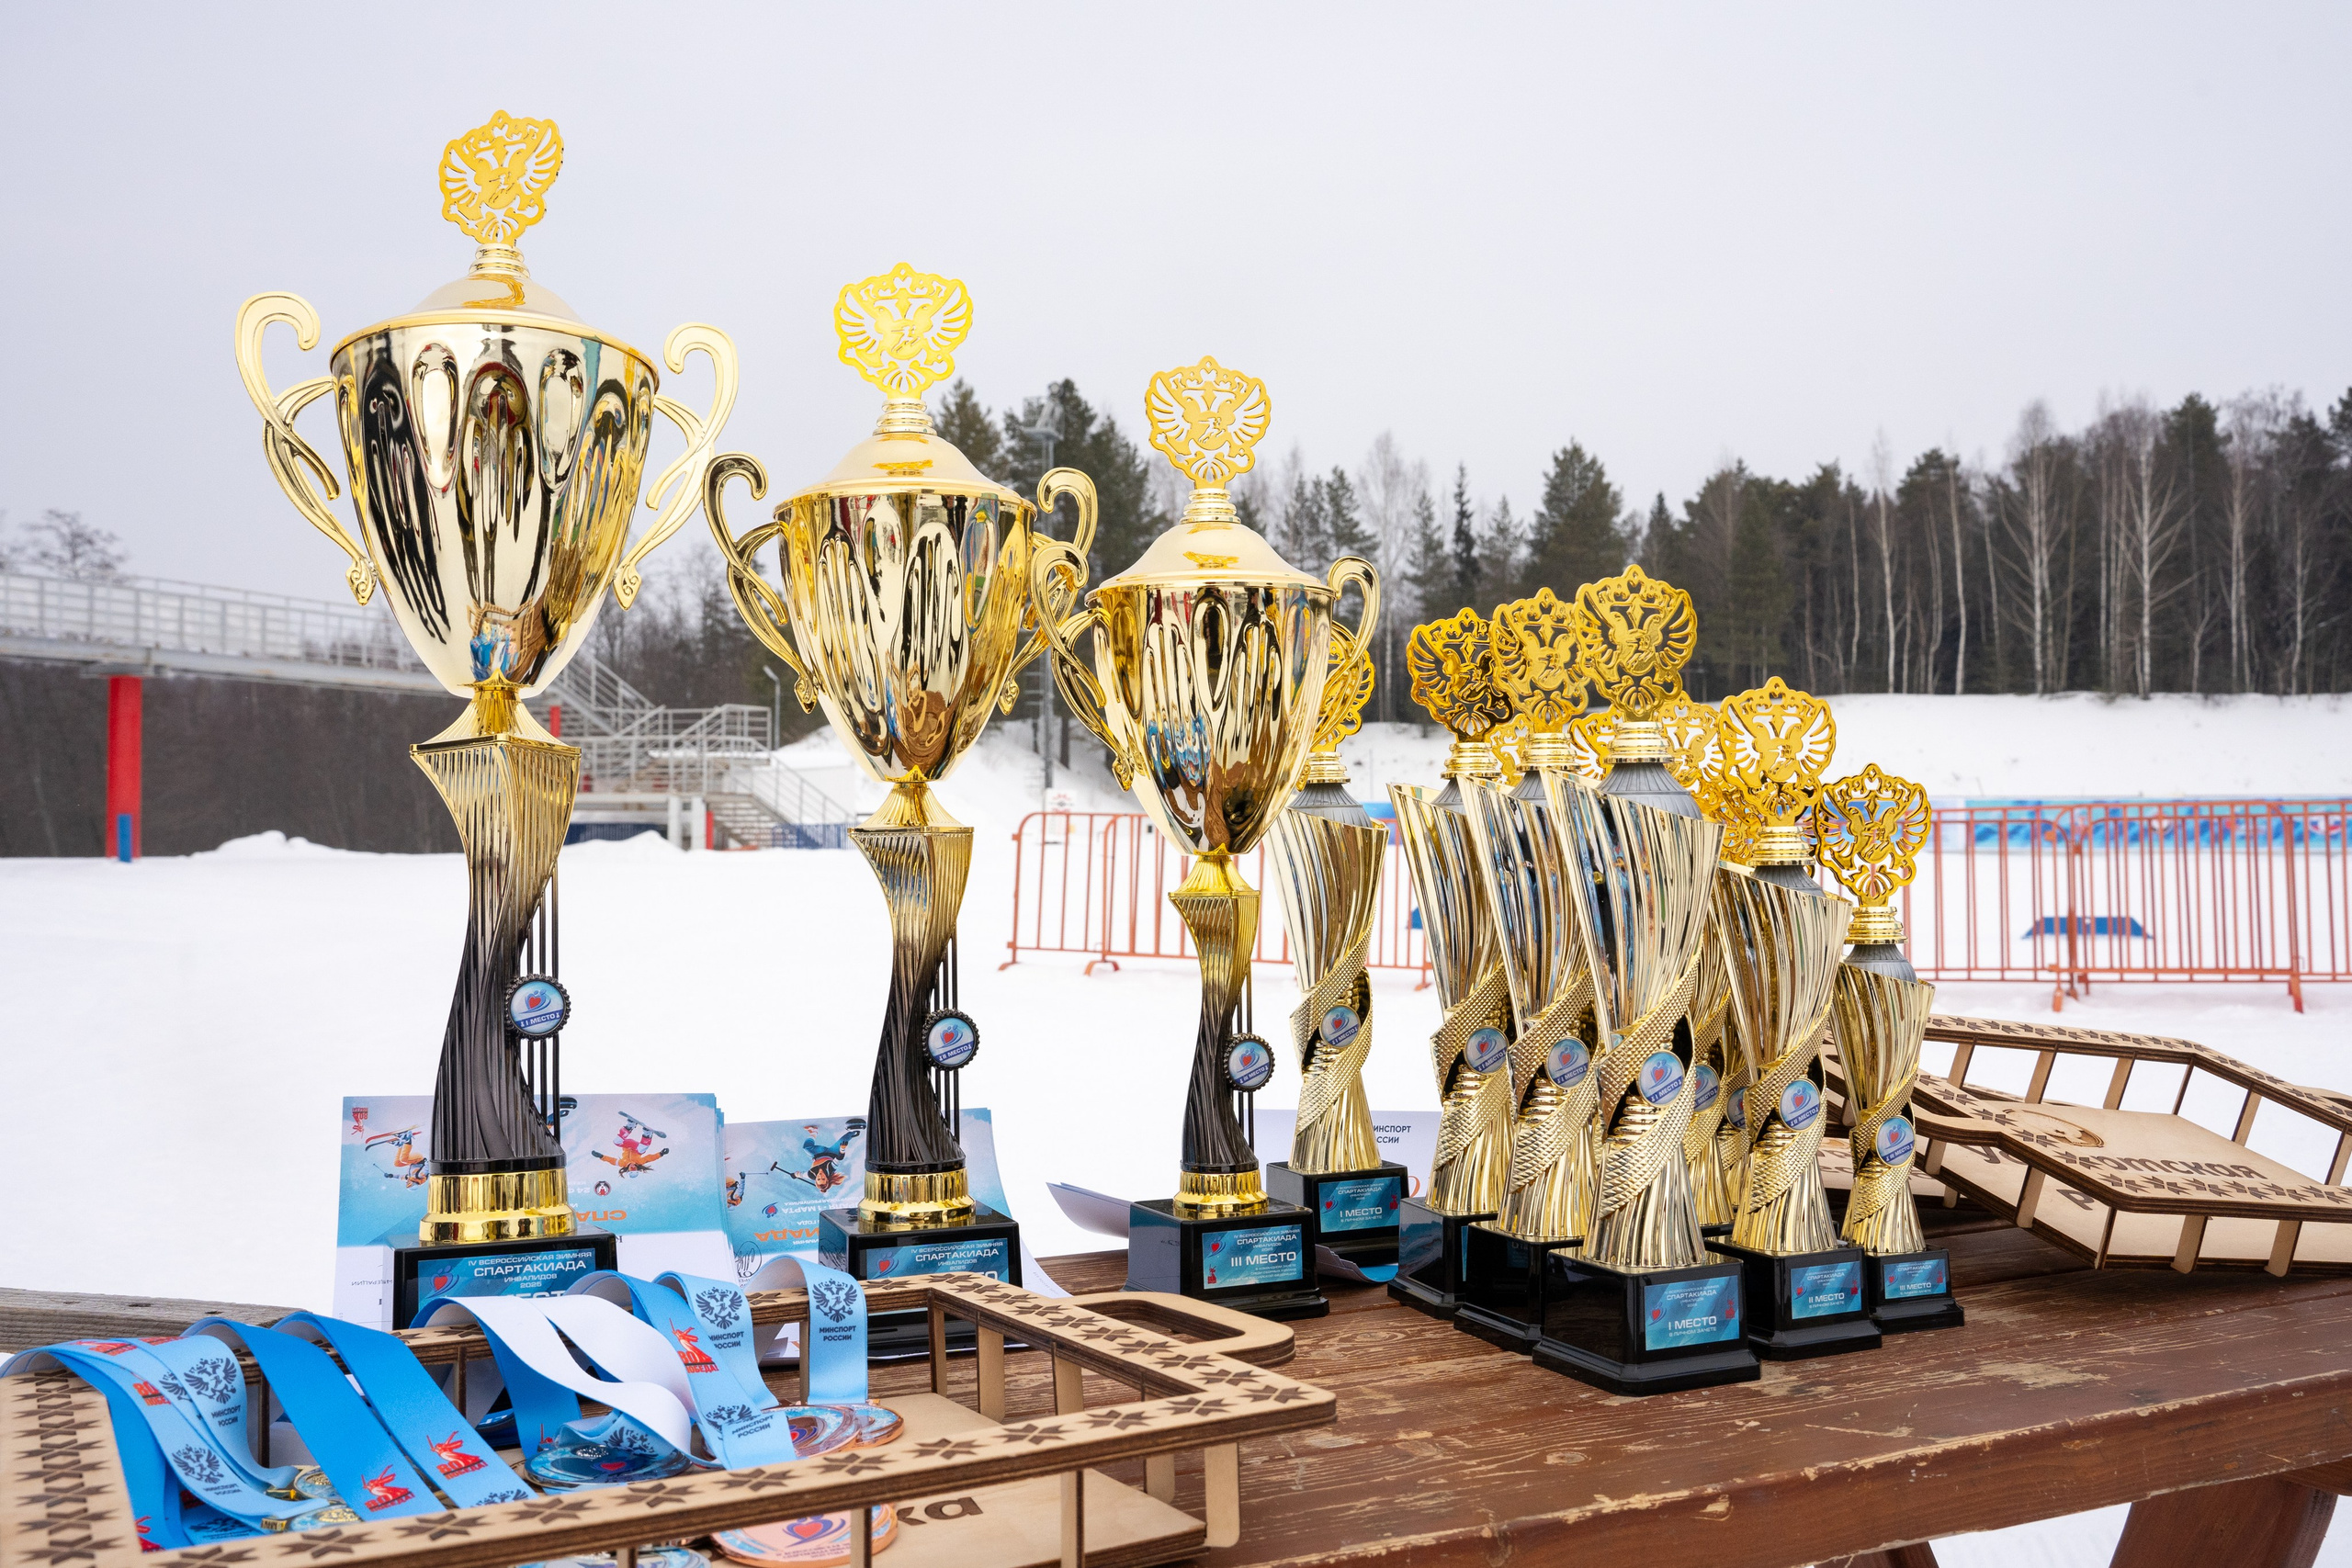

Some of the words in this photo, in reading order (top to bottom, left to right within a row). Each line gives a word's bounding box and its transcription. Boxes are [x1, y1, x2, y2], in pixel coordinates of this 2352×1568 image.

[530, 1013, 555, 1024] МЕСТО
[947, 1045, 968, 1057] МЕСТО
[1249, 1066, 1265, 1078] МЕСТО
[1564, 1067, 1584, 1080] МЕСТО
[1658, 1081, 1679, 1098] МЕСТО
[1798, 1109, 1816, 1122] МЕСТО
[1373, 1125, 1411, 1134] ИНСПОРТ
[781, 1205, 816, 1214] МАРТА
[1345, 1207, 1383, 1218] МЕСТО
[753, 1228, 820, 1242] ИАДА
[1237, 1234, 1297, 1246] СПАРТАКИАДА
[919, 1244, 975, 1253] ВСЕРОССИЙСКАЯ
[479, 1254, 555, 1266] ВСЕРОССИЙСКАЯ
[556, 1251, 593, 1260] ЗИМНЯЯ
[915, 1248, 999, 1262] СПАРТАКИАДА
[1231, 1257, 1242, 1267] III
[1246, 1251, 1296, 1266] МЕСТО
[474, 1260, 586, 1277] СПАРТАКИАДА
[504, 1273, 558, 1282] ИНВАЛИДОВ
[1906, 1282, 1932, 1291] МЕСТО
[1667, 1290, 1717, 1301] СПАРТАКИАДА
[1815, 1292, 1845, 1303] МЕСТО
[1674, 1316, 1717, 1330] МЕСТО
[819, 1325, 856, 1334] МИНСПОРТ
[211, 1405, 241, 1418] МИНСПОРТ
[218, 1416, 238, 1427] РОССИИ
[732, 1415, 774, 1435] МИНСПОРТ
[738, 1423, 771, 1438] РОССИИ
